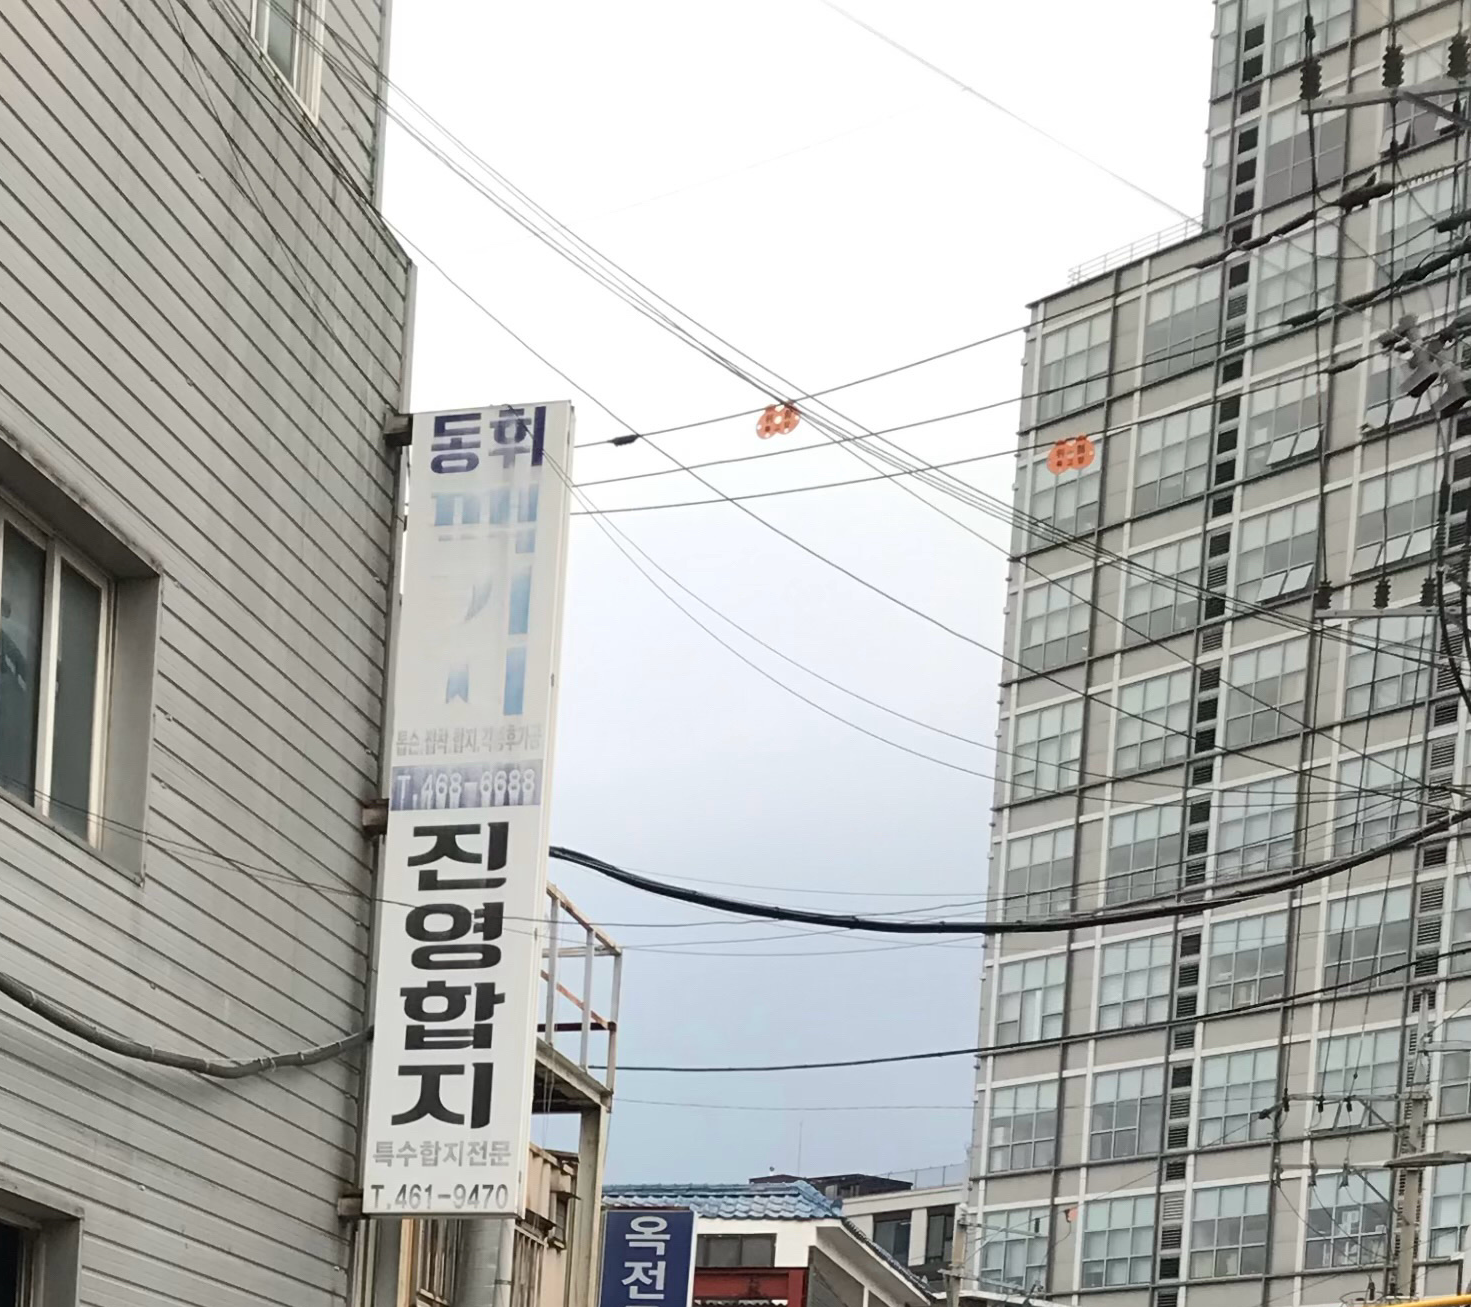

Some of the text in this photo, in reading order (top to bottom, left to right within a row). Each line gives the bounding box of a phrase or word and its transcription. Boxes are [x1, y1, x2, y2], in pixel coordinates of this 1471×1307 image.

[391, 821, 510, 1130] 진영합지
[372, 1139, 512, 1169] 특수합지전문
[370, 1182, 509, 1211] T.461-9470
